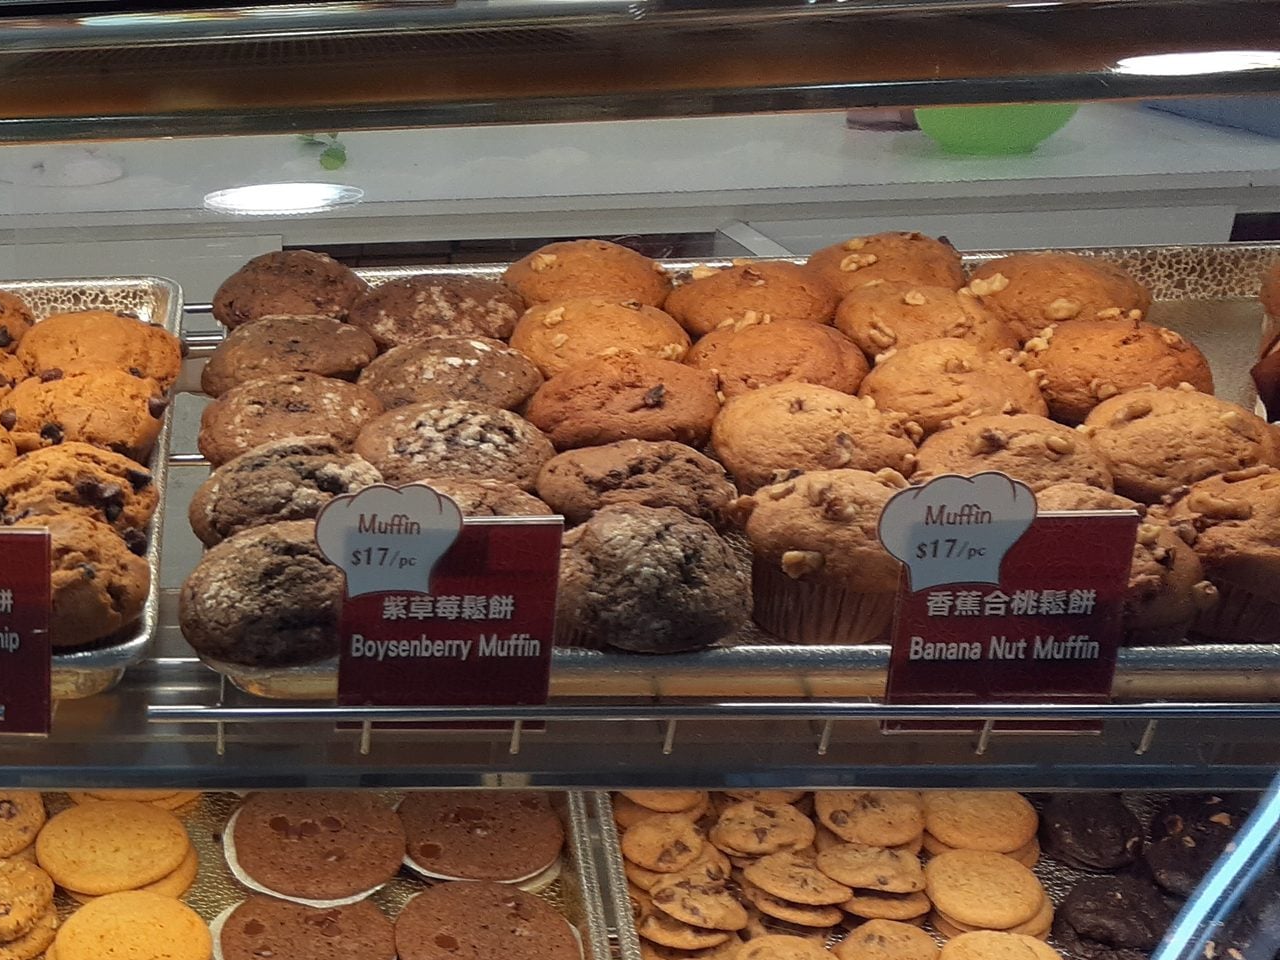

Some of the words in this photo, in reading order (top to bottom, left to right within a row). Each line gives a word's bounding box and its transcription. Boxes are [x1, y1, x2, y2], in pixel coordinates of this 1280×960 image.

[358, 513, 421, 536] Muffin
[924, 503, 992, 527] Muffin
[351, 547, 417, 569] $17/pc
[916, 538, 987, 561] $17/pc
[382, 594, 515, 621] 紫草莓鬆餅
[926, 588, 1097, 617] 香蕉合桃鬆餅
[351, 634, 472, 661] Boysenberry
[478, 634, 541, 657] Muffin
[909, 636, 982, 661] Banana
[988, 636, 1027, 661] Nut
[1032, 635, 1100, 661] Muffin
